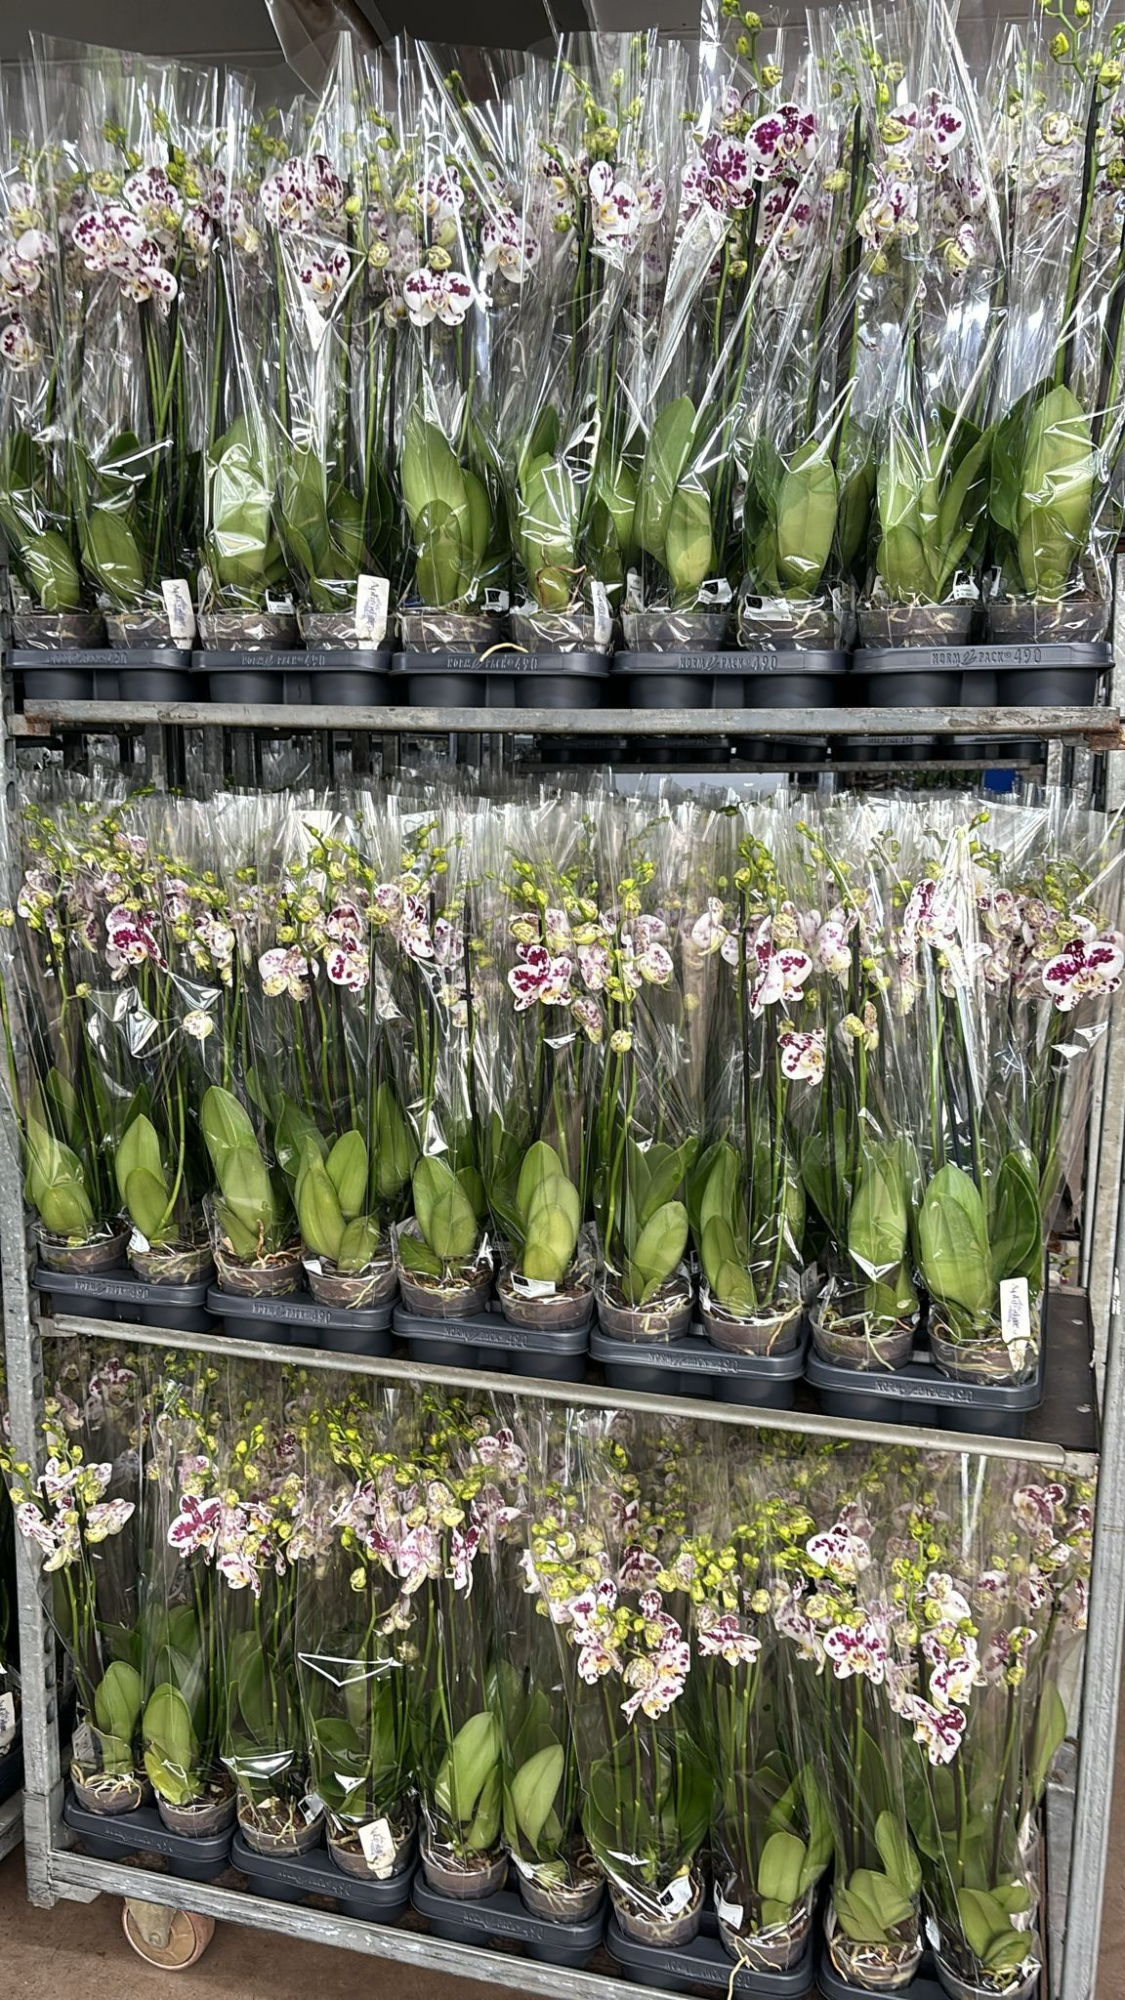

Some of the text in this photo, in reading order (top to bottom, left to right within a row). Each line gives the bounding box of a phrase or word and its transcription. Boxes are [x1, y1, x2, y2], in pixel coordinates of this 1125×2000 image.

[753, 655, 778, 671] 490
[932, 651, 960, 666] NORM
[1013, 648, 1042, 664] 490
